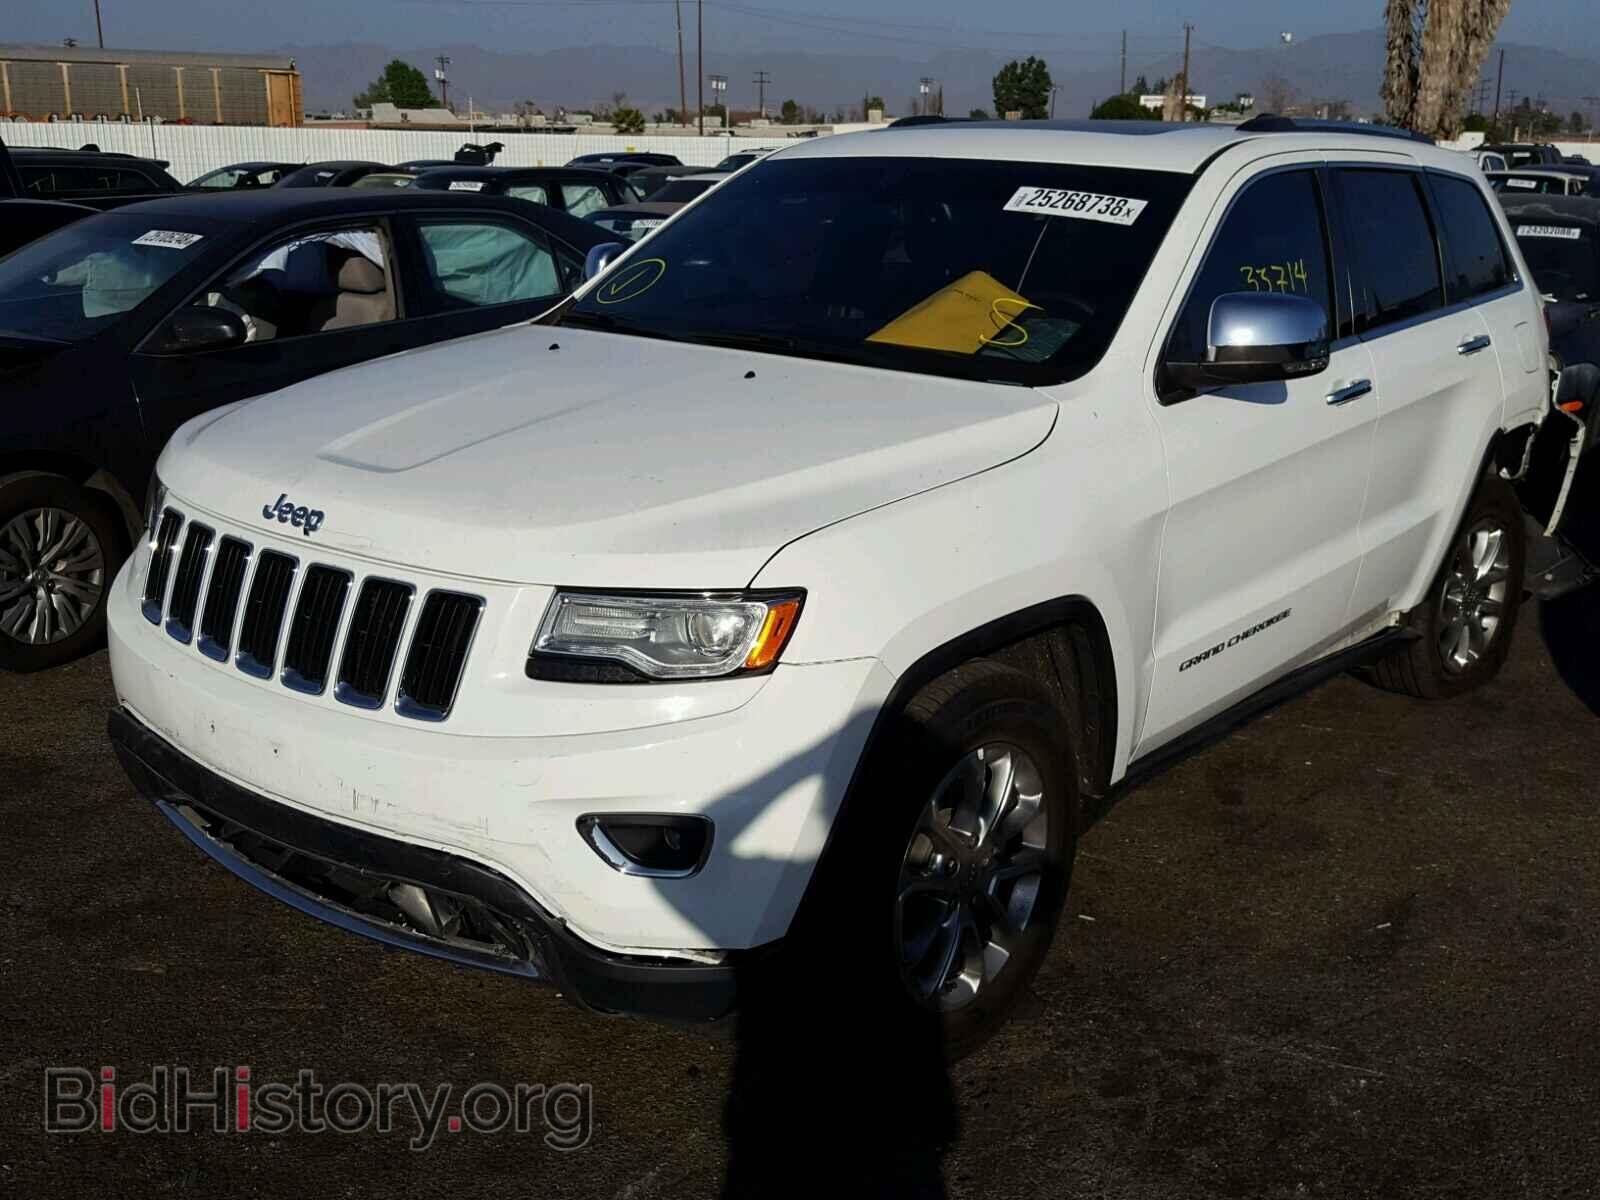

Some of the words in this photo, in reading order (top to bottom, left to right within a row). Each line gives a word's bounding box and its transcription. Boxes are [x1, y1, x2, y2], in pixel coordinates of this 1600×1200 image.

[262, 493, 325, 537] Jeep
[1178, 642, 1225, 672] GRAND
[1226, 608, 1292, 648] CHEROKEE
